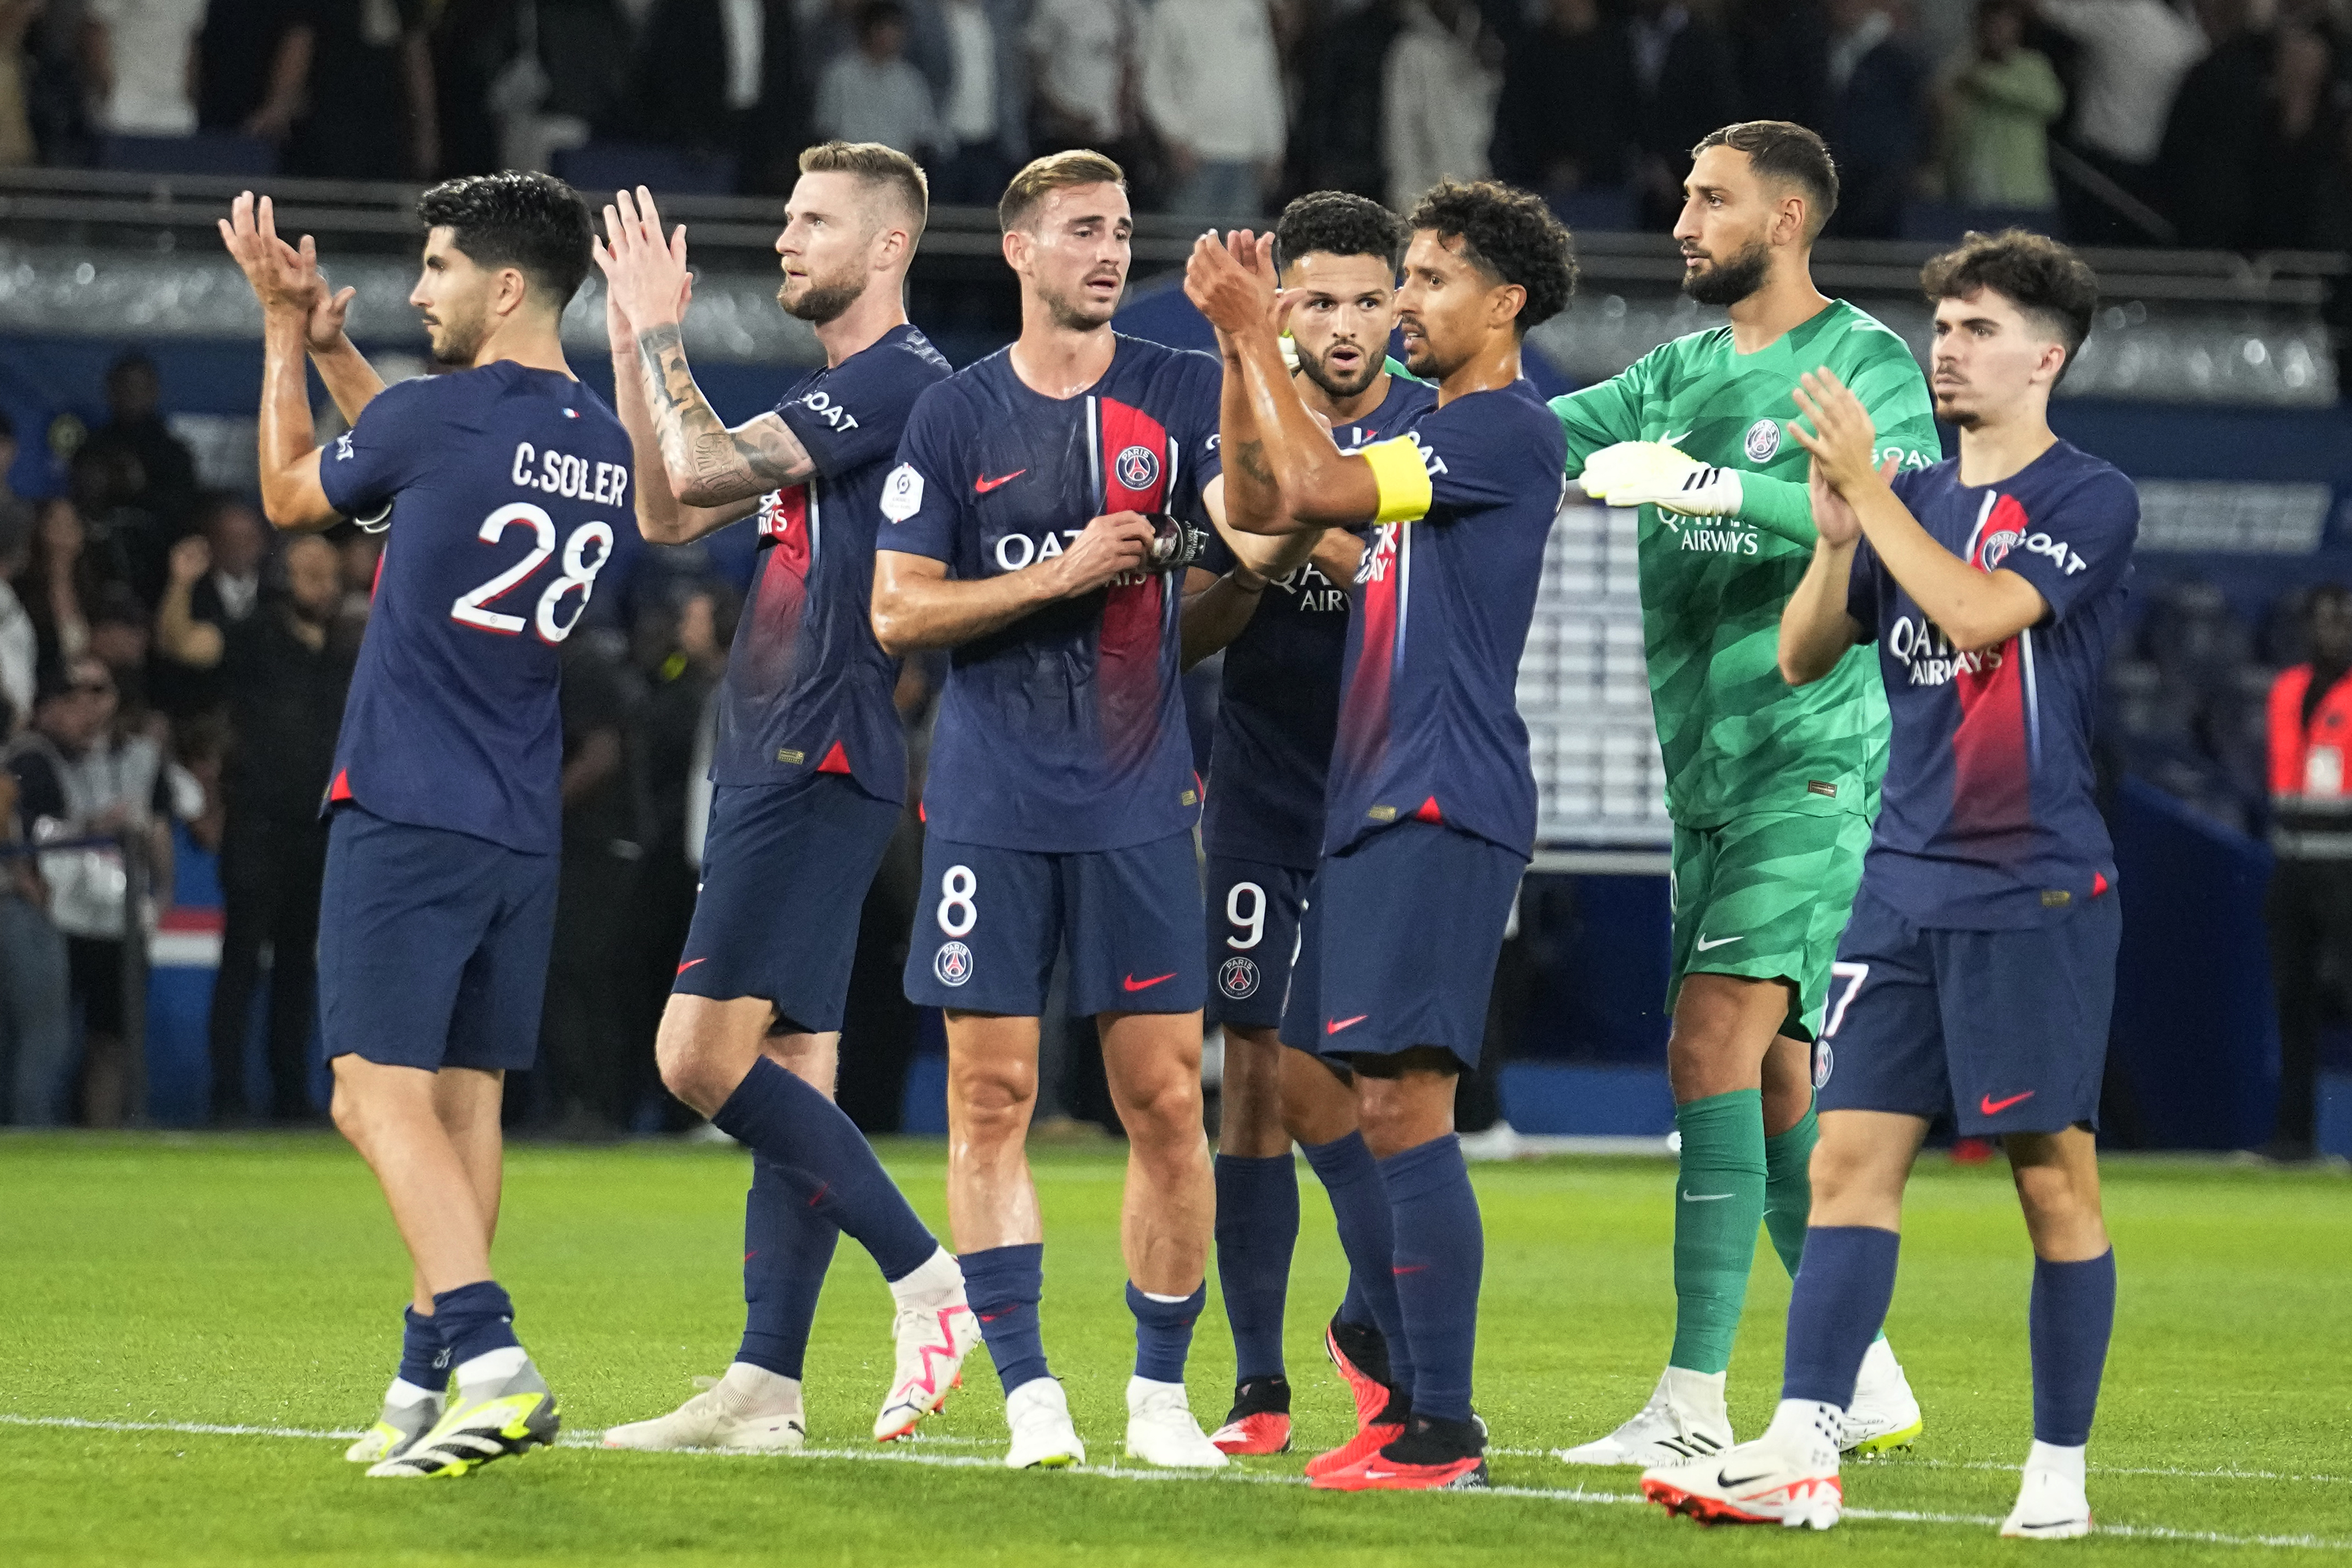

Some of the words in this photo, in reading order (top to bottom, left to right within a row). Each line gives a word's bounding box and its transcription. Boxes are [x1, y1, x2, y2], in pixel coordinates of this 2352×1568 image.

[802, 391, 859, 432] OAT
[512, 441, 628, 508] C.SOLER
[1122, 448, 1150, 461] PARIS
[450, 502, 614, 645] 28
[1300, 589, 1352, 612] AIR
[937, 864, 978, 937] 8
[1226, 882, 1267, 950] 9
[944, 944, 968, 956] PARIS
[1226, 959, 1253, 970] PARIS
[1819, 962, 1870, 1037] 7
